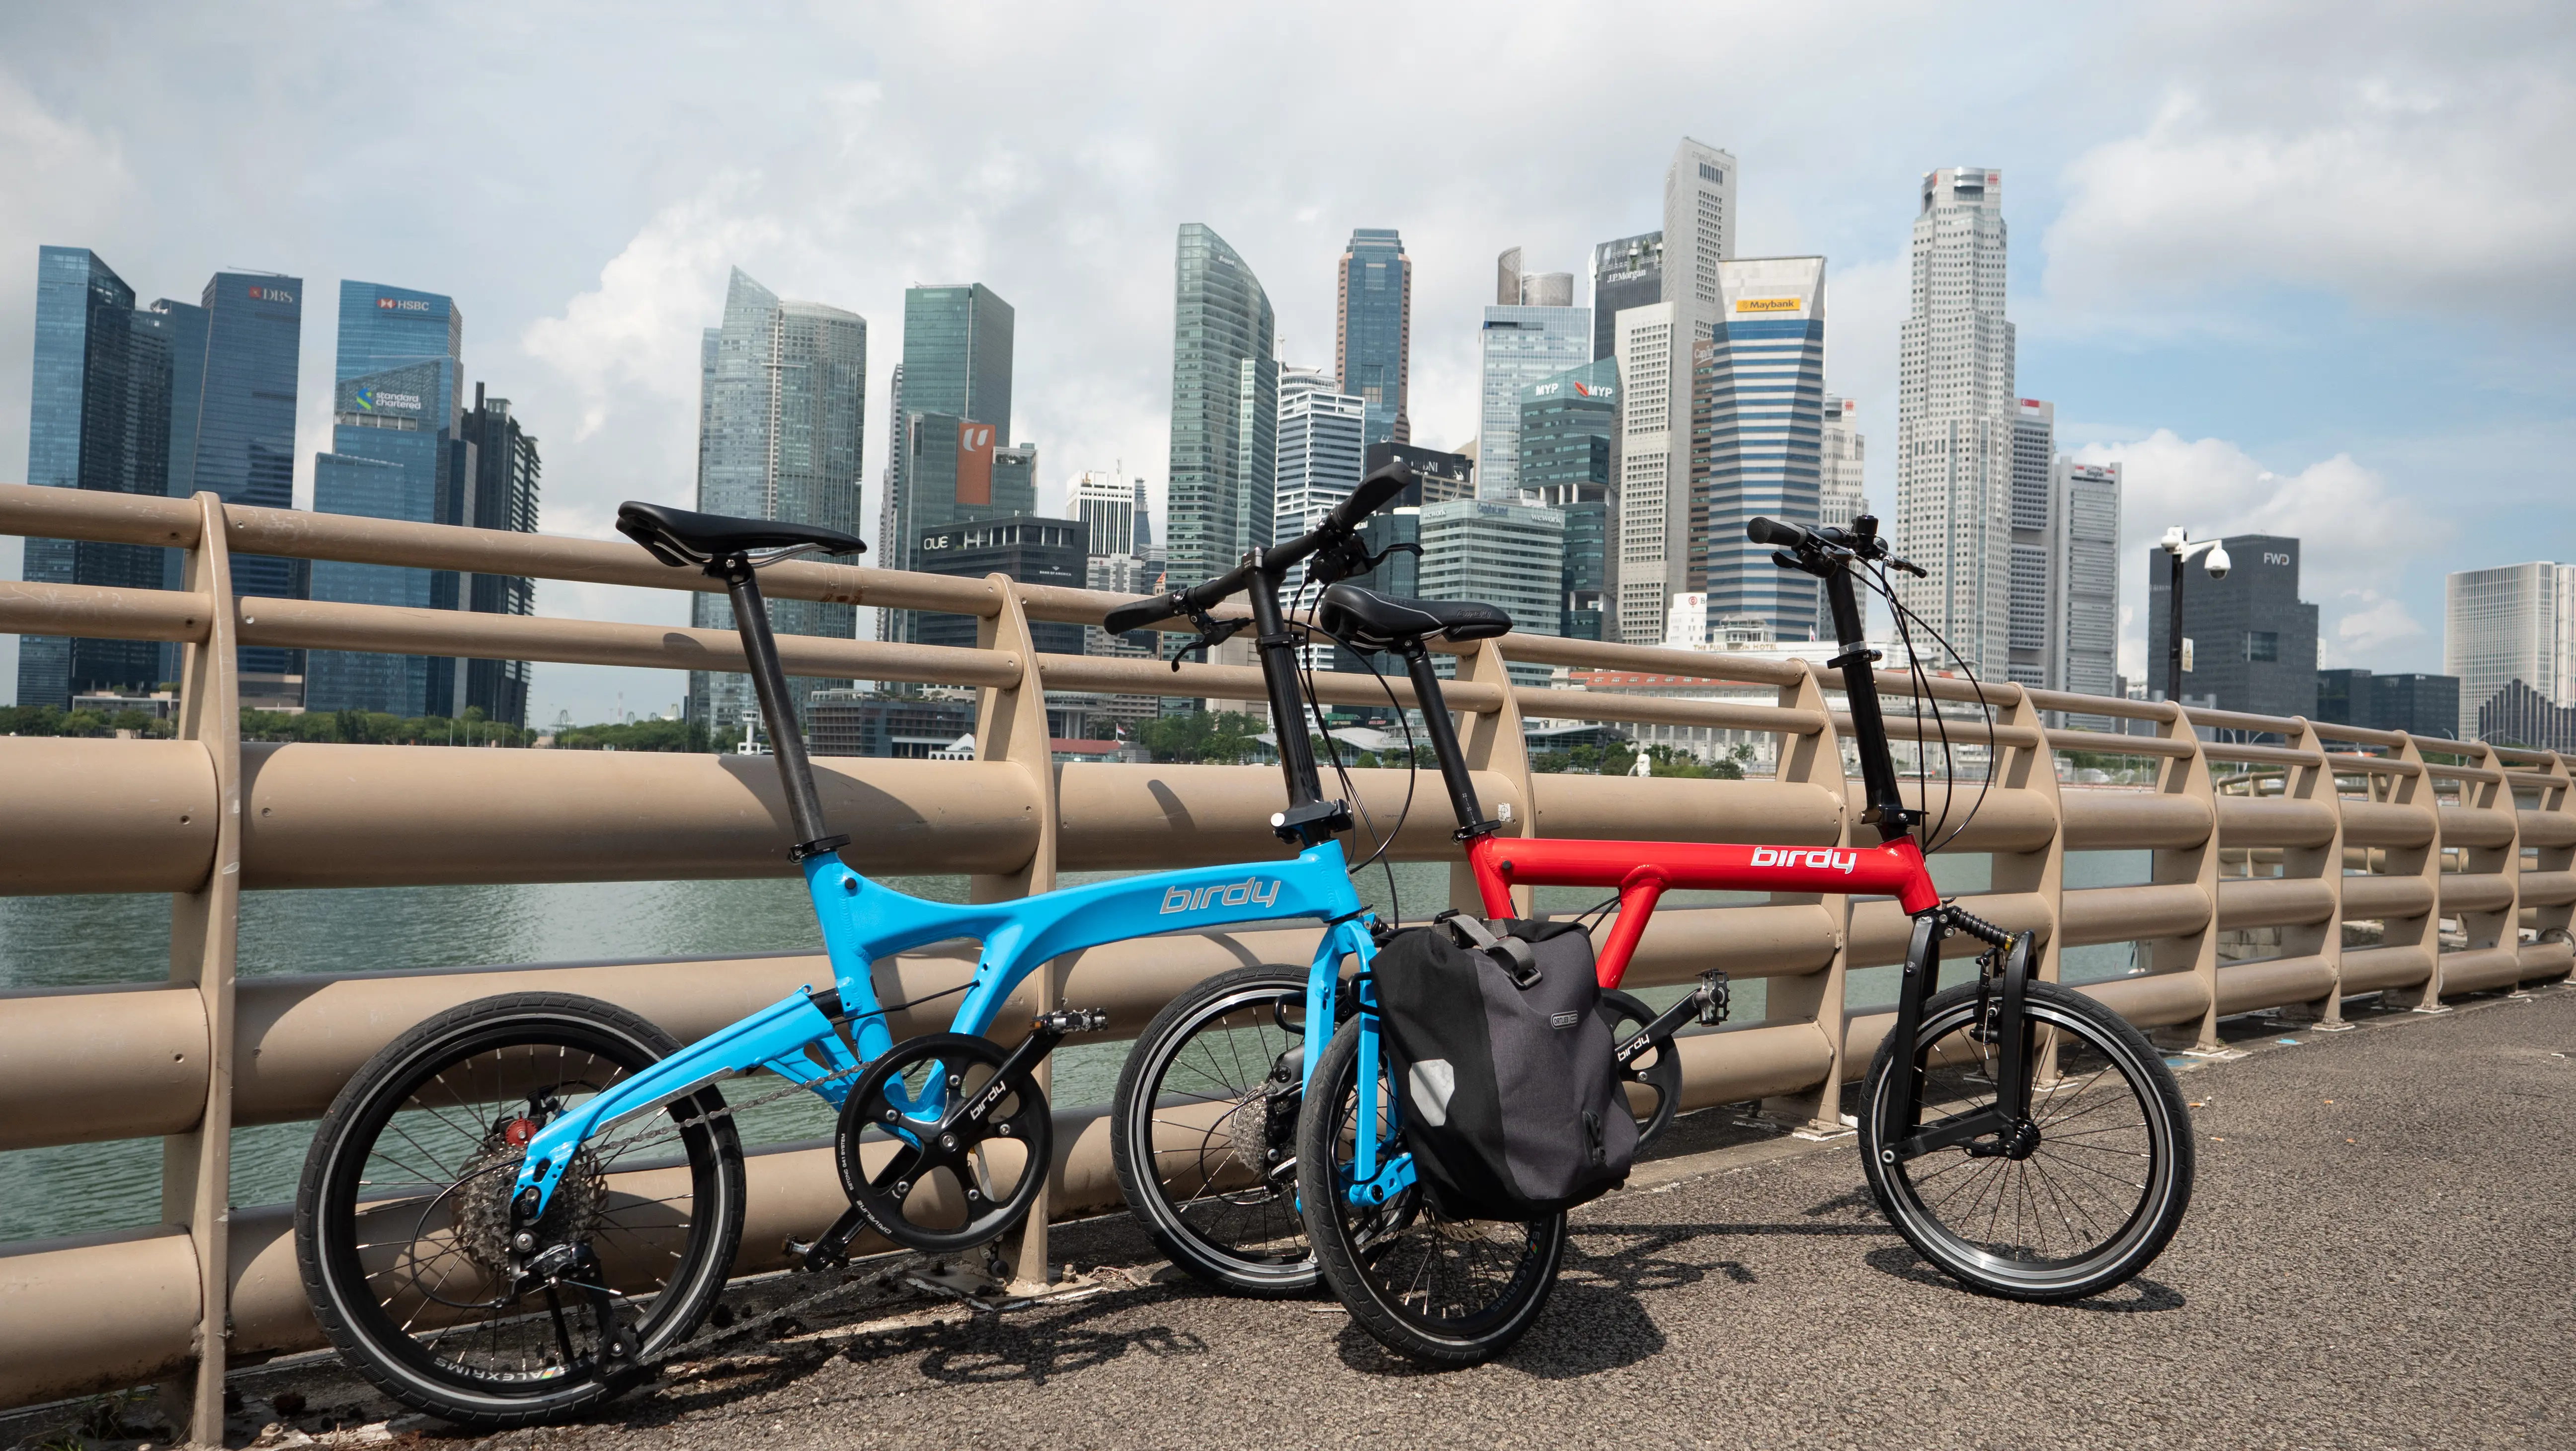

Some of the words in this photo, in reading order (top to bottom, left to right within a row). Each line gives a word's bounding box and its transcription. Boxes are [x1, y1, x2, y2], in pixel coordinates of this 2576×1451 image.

[1607, 269, 1646, 283] J.P.Morgan
[263, 288, 293, 303] DBS
[398, 300, 429, 311] HSBC
[1750, 299, 1794, 310] Maybank
[1535, 383, 1559, 396] MYP
[1588, 385, 1613, 398] MYP
[376, 392, 419, 403] standard
[376, 399, 421, 410] chartered
[1423, 506, 1447, 518] wework
[1477, 502, 1509, 517] CapitaLand
[1531, 512, 1562, 523] wework
[924, 535, 948, 551] OUE
[2264, 552, 2290, 565] FWD
[1456, 609, 1492, 619] birdy
[1750, 847, 1857, 875] birdy
[1159, 877, 1281, 914] birdy
[1554, 1016, 1569, 1025] ORTLIEB
[1617, 1034, 1650, 1062] birdy
[970, 1080, 1006, 1121] birdy
[1491, 1250, 1534, 1312] ALEXRIMS
[433, 1357, 544, 1381] ALEXRIMS
